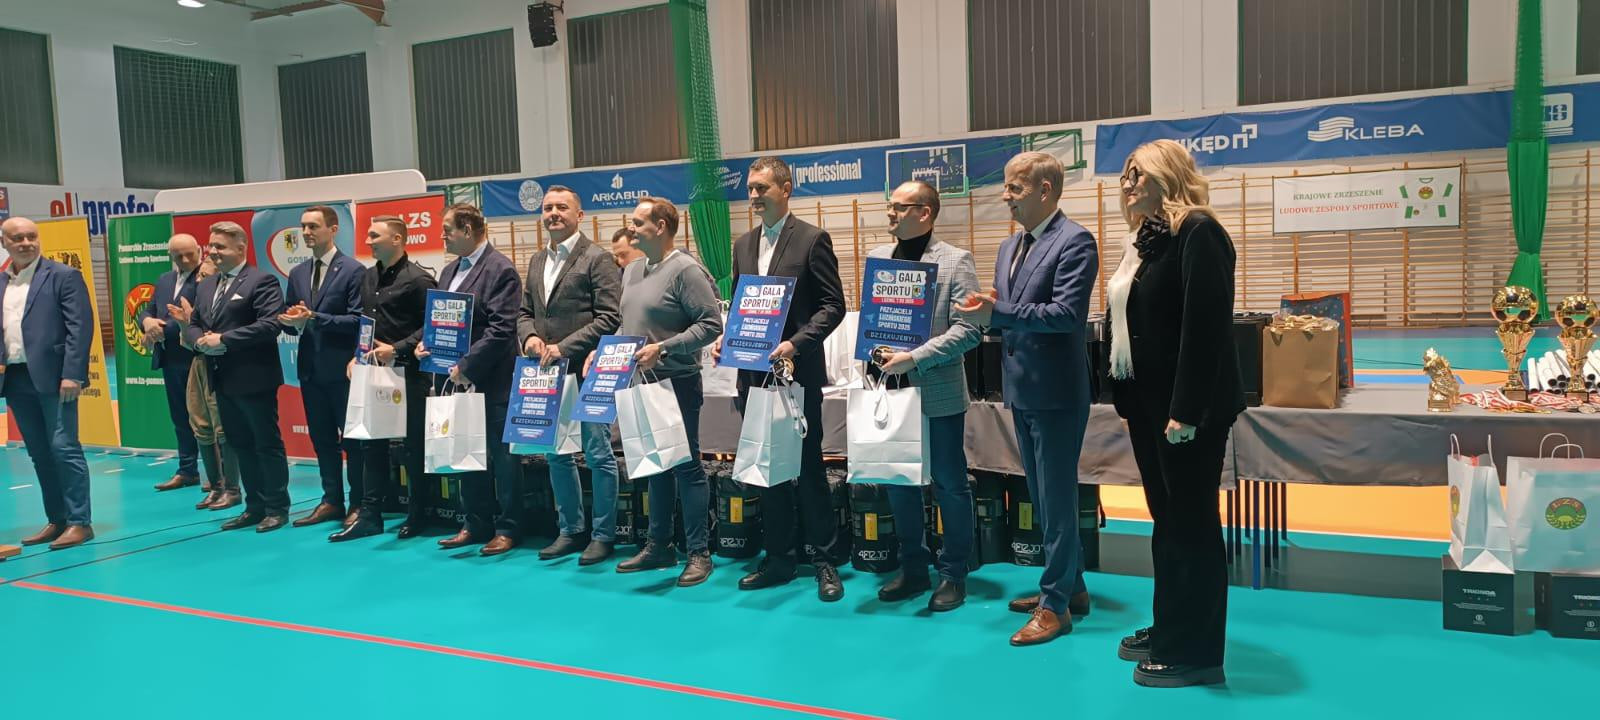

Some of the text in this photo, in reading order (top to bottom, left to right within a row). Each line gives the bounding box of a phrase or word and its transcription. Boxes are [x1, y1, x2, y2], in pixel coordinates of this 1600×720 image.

[1345, 125, 1425, 141] KLEBA
[1175, 136, 1230, 154] IKĘD
[796, 158, 862, 188] professional
[592, 190, 654, 202] ARKABUD
[1293, 189, 1383, 201] KRAJOWE ZRZESZENIE
[1279, 201, 1400, 215] LUDOWE ZESPOŁY SPORTOWE
[82, 194, 154, 235] profe
[898, 272, 922, 283] GALA
[763, 286, 781, 296] GALA
[876, 285, 911, 296] SPORTU
[742, 298, 770, 308] SPORTU
[434, 311, 456, 320] SPORTU
[617, 344, 633, 354] GALA
[521, 378, 547, 388] SPORTU
